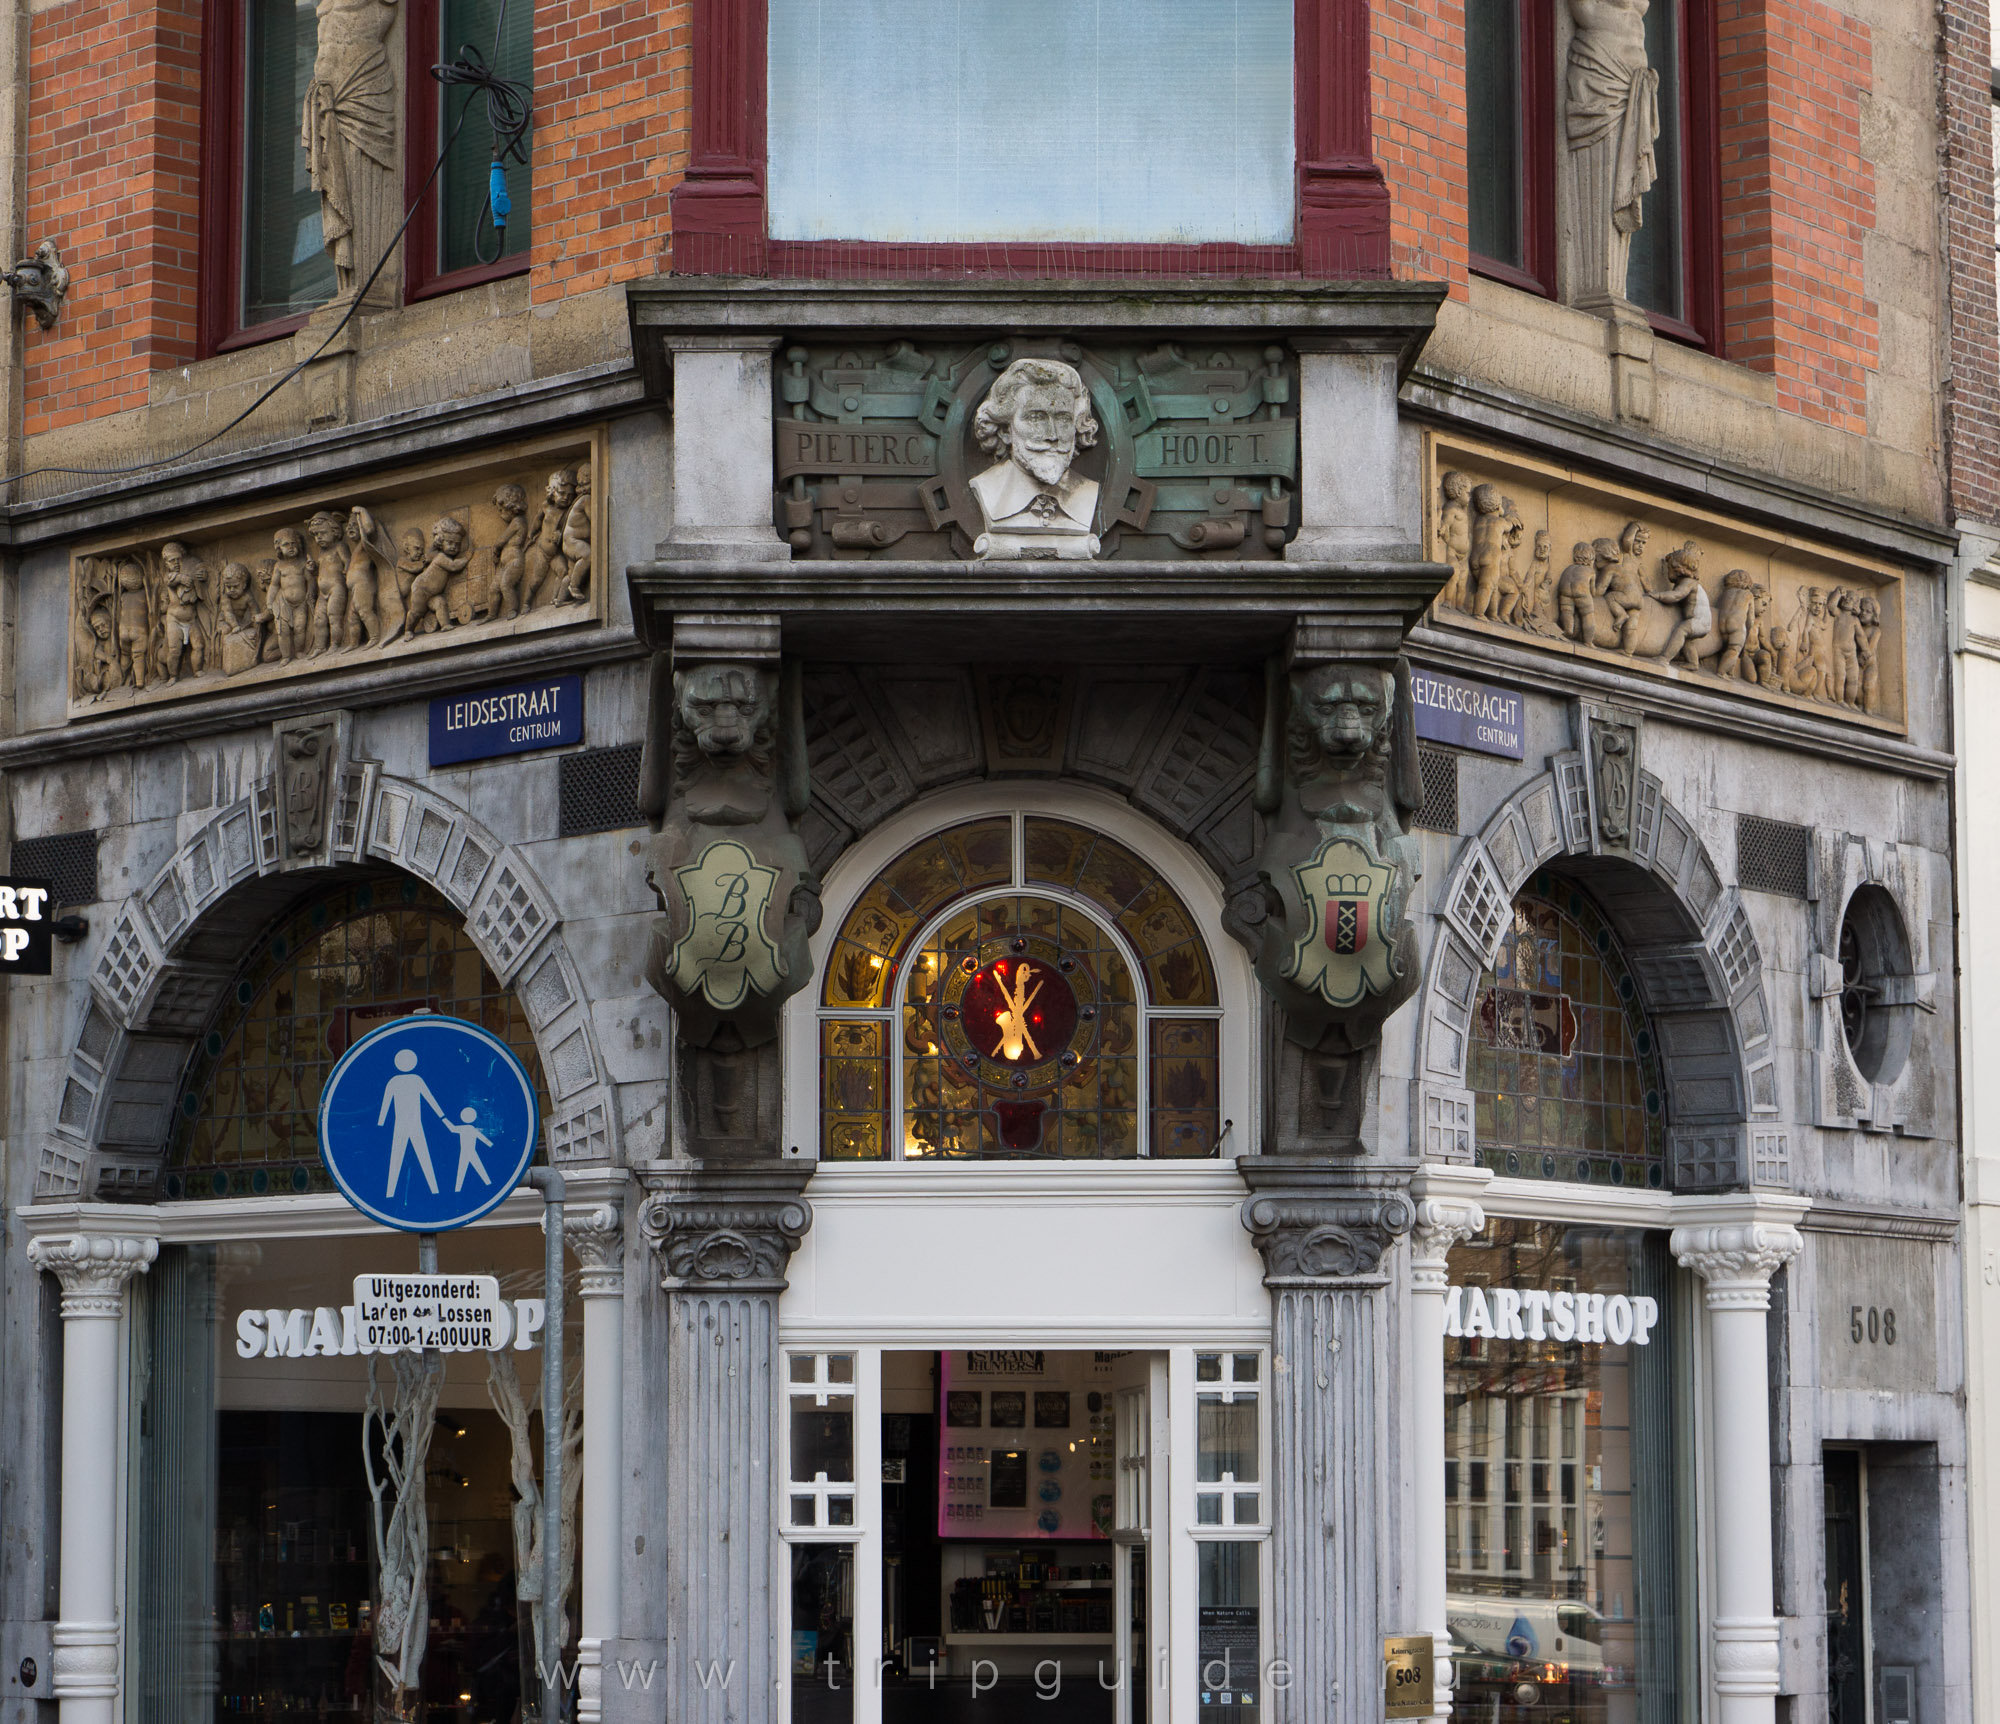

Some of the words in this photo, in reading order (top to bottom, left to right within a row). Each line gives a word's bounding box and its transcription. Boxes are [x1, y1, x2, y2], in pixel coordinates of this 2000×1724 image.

[1161, 434, 1270, 465] HOOFT.
[446, 686, 561, 731] LEIDSESTRAAT
[509, 720, 561, 743] CENTRUM
[1477, 725, 1518, 749] CENTRUM
[0, 927, 30, 961] P
[372, 1278, 480, 1303] Uitgezonderd:
[437, 1302, 492, 1323] Lossen
[1851, 1305, 1897, 1346] 508
[973, 1360, 1037, 1371] HUNTERS
[974, 1351, 1036, 1362] STRAIN
[1395, 1666, 1422, 1688] 508
